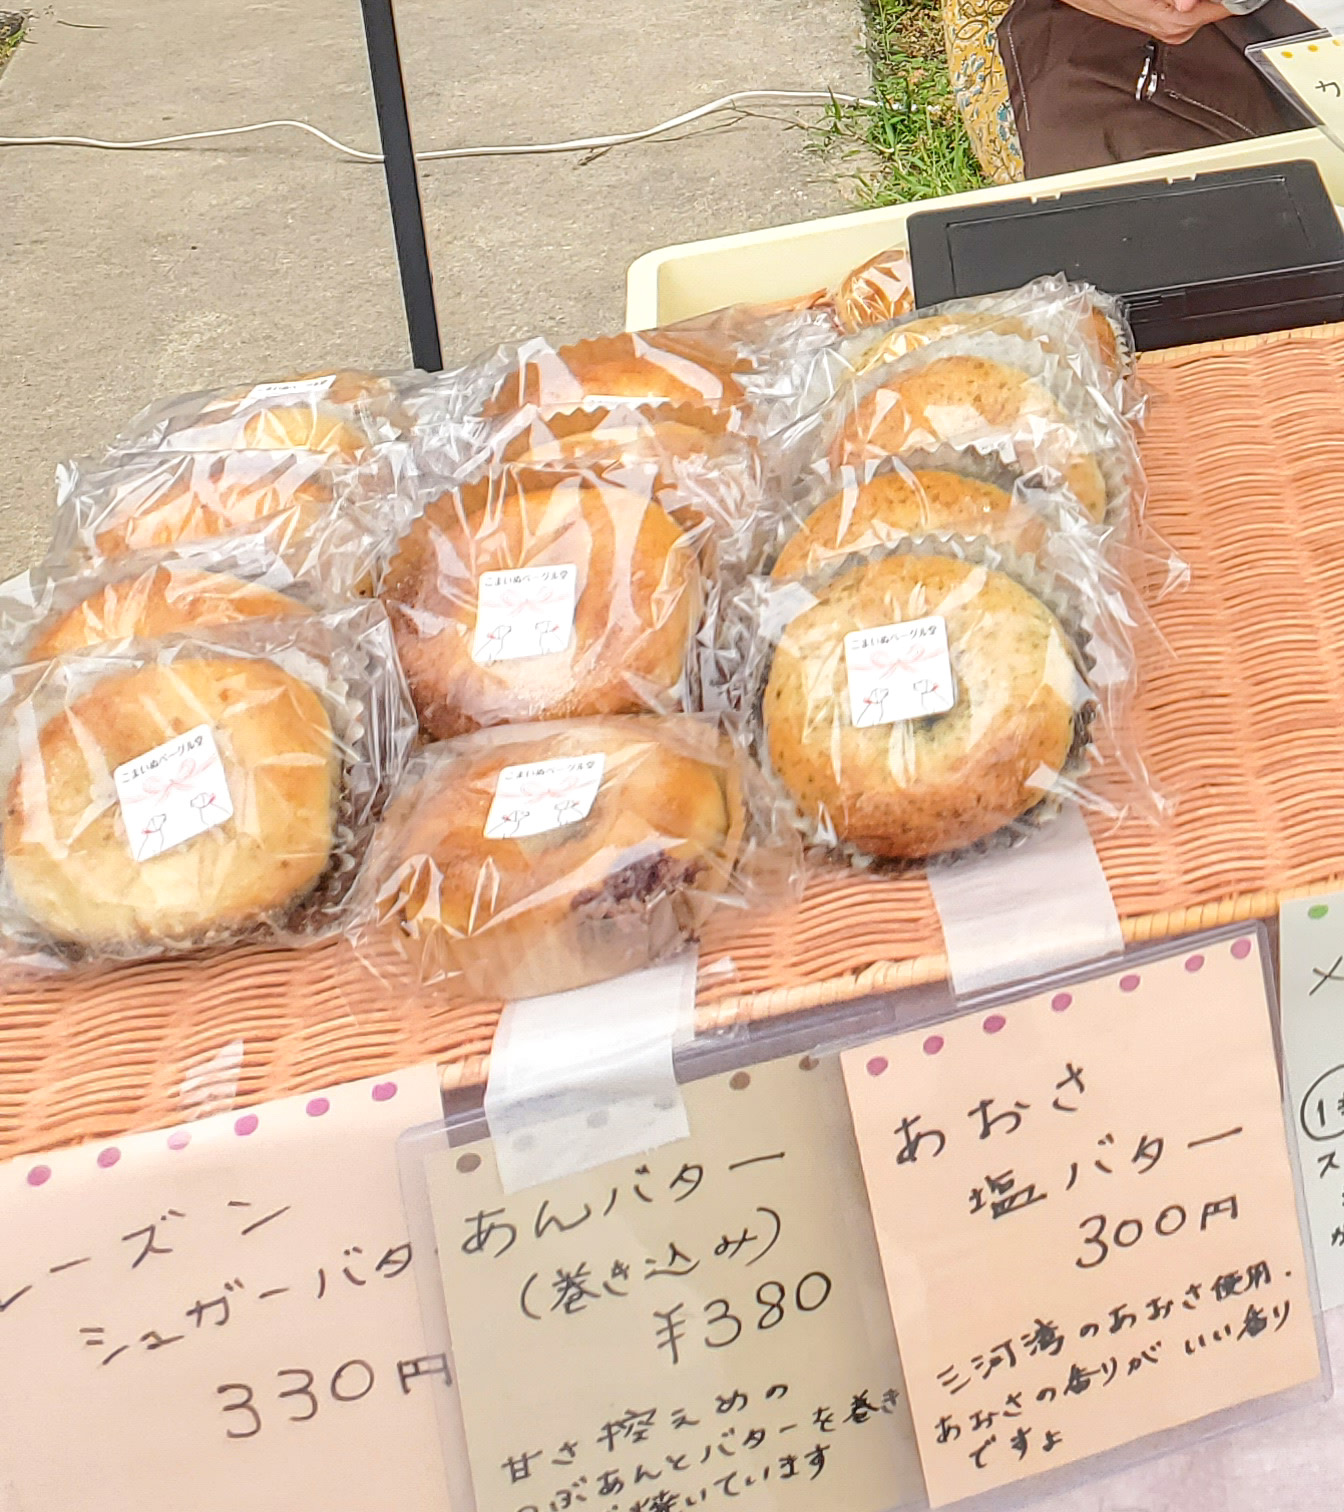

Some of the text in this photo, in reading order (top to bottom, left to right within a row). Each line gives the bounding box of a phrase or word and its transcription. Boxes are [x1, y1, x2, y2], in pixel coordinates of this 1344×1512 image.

[895, 1063, 1085, 1165] あおさ
[461, 1151, 786, 1257] あんバター
[968, 1126, 1242, 1218] 塩バター
[1075, 1196, 1238, 1269] 300円
[79, 1242, 413, 1366] シュガーバタ
[654, 1271, 831, 1364] ¥380
[217, 1353, 452, 1438] 330円
[501, 1384, 788, 1483] 甘さ控えめの
[605, 1444, 831, 1512] 焼いています
[969, 1427, 1062, 1468] ですよ
